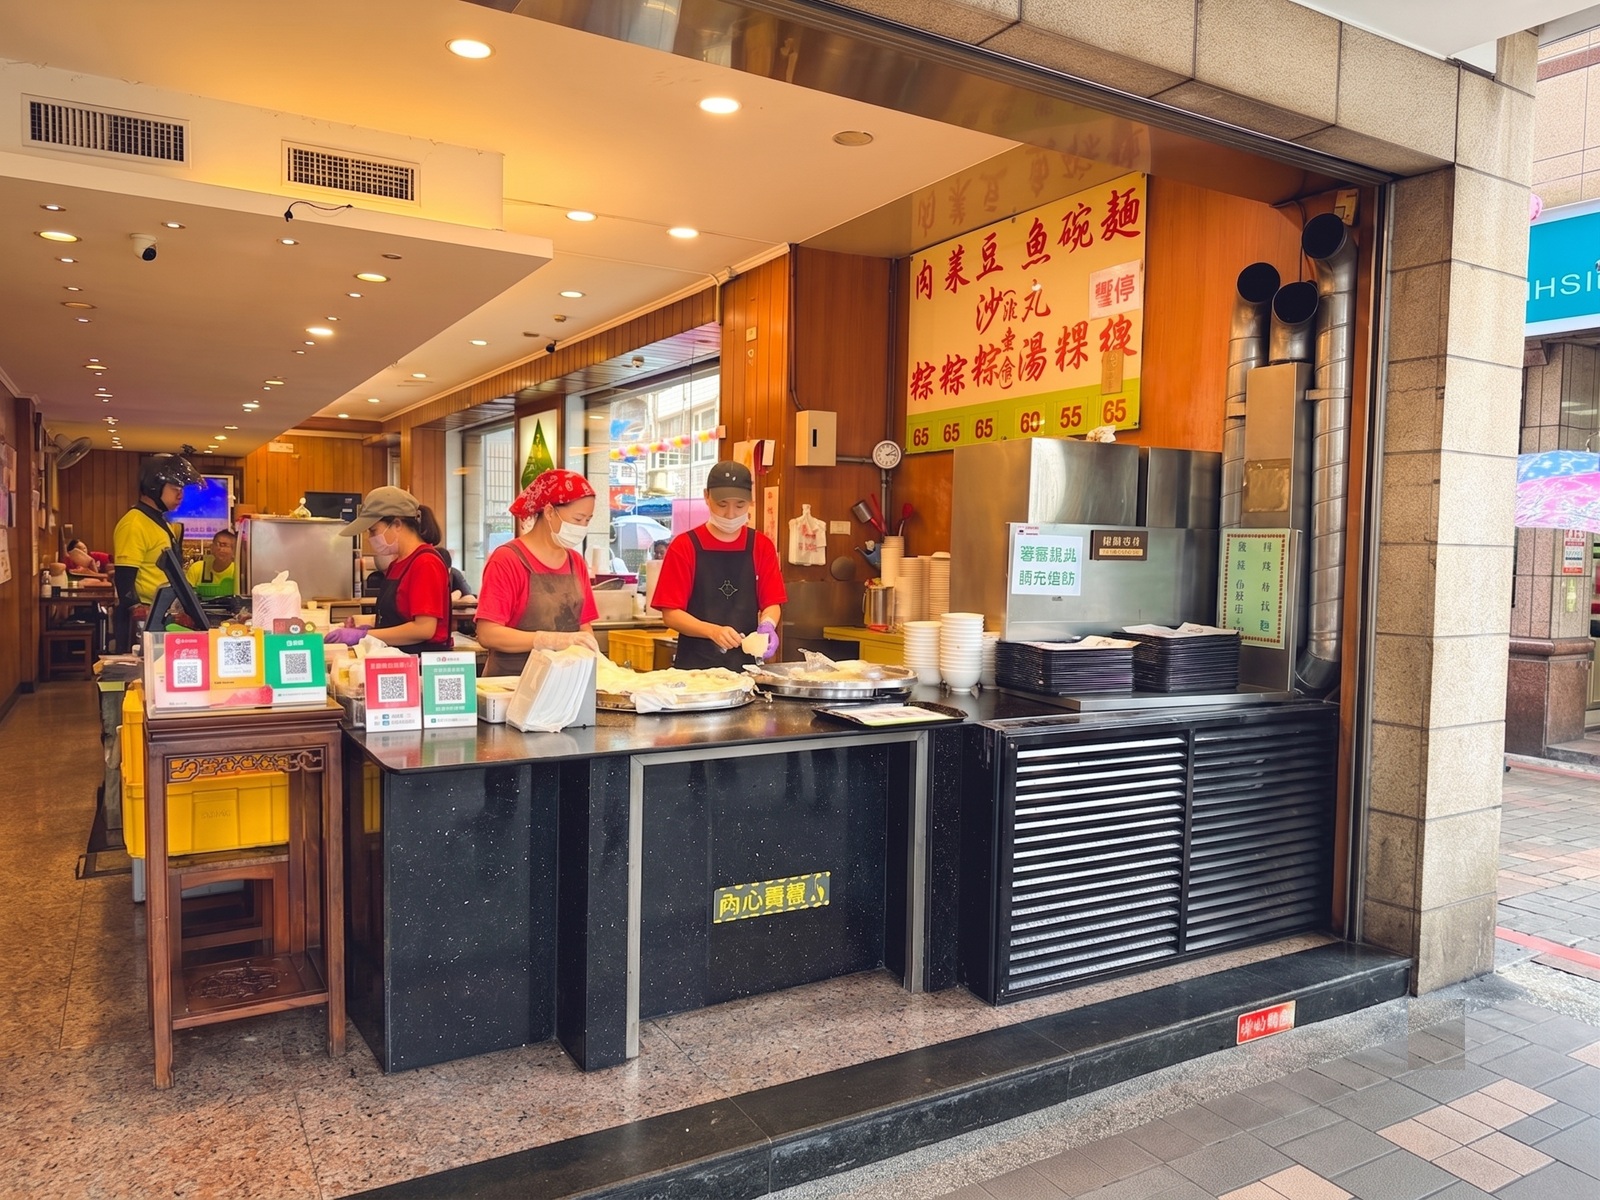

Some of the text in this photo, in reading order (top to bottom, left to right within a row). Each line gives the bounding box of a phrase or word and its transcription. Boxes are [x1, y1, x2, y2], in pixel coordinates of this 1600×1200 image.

[1060, 405, 1082, 429] 55
[1103, 398, 1126, 423] 65
[943, 422, 960, 443] 65
[974, 418, 993, 439] 65
[1020, 411, 1041, 434] 60
[913, 427, 929, 447] 65
